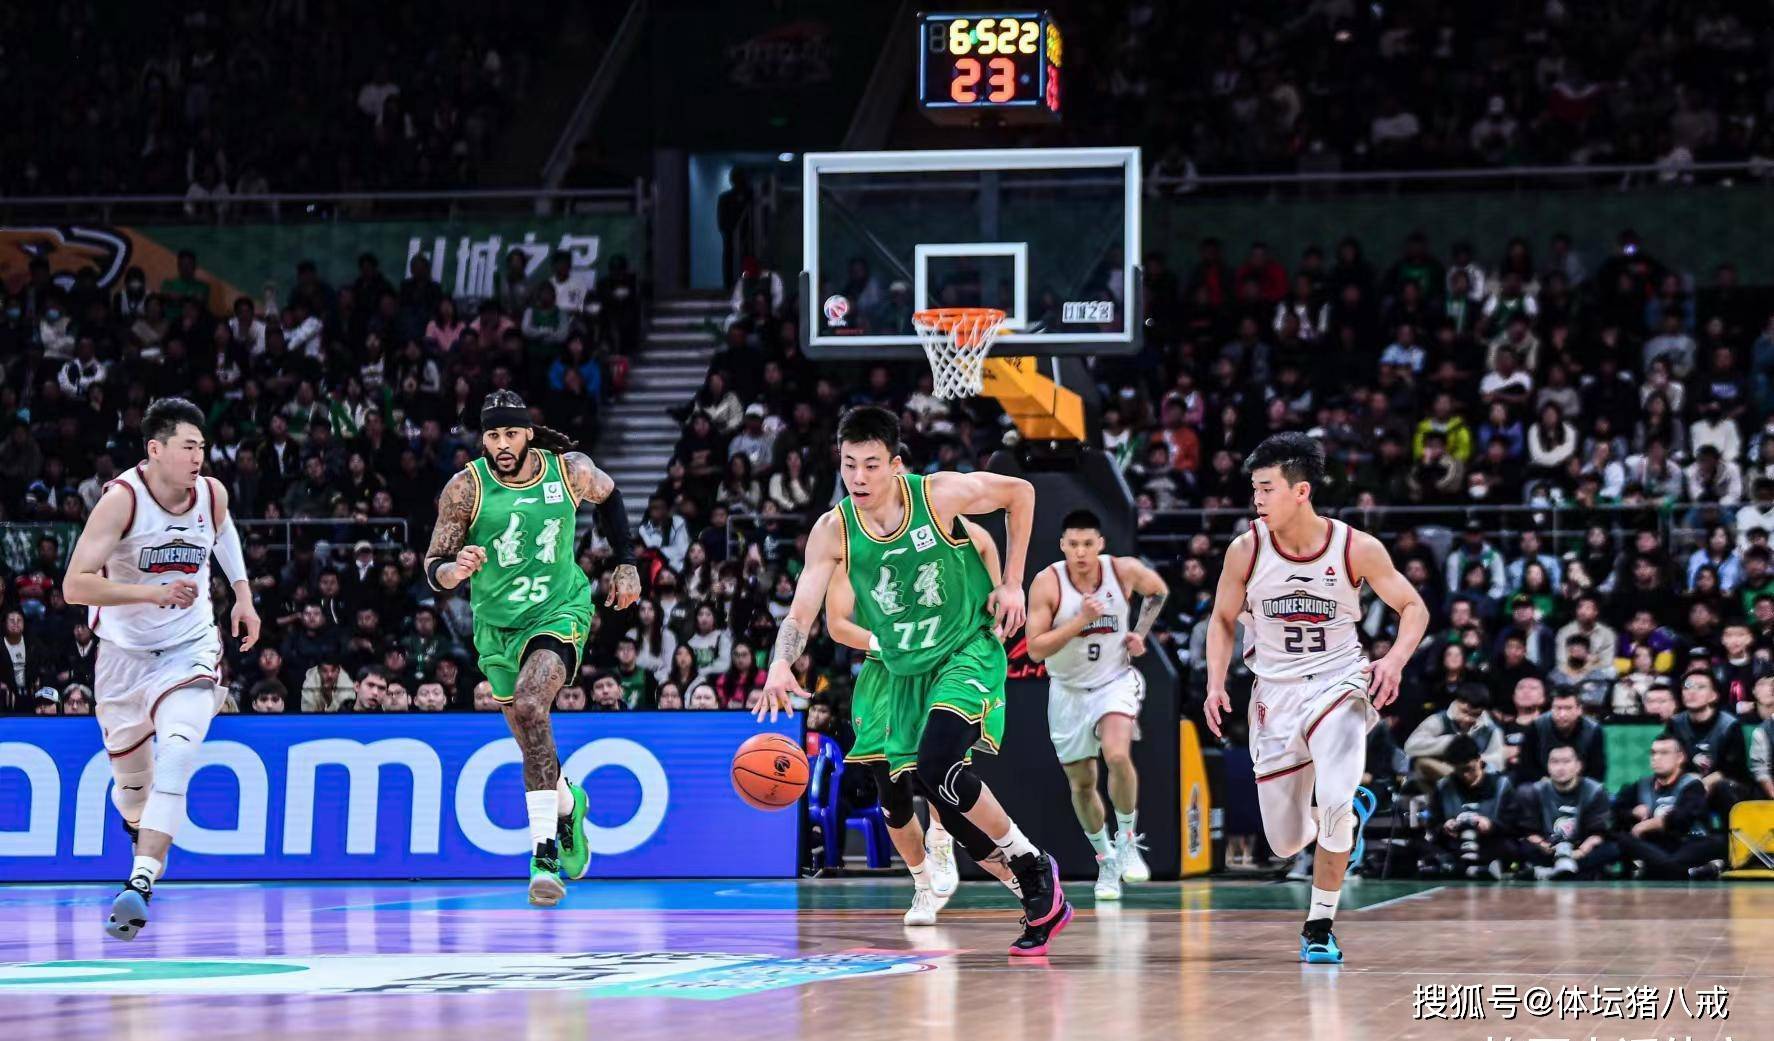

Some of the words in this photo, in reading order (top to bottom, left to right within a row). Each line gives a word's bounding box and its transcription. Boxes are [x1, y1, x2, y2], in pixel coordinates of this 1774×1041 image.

[951, 57, 1015, 103] 23
[508, 576, 552, 603] 25
[893, 615, 942, 650] 77
[1283, 626, 1327, 653] 23
[1087, 642, 1101, 662] 9
